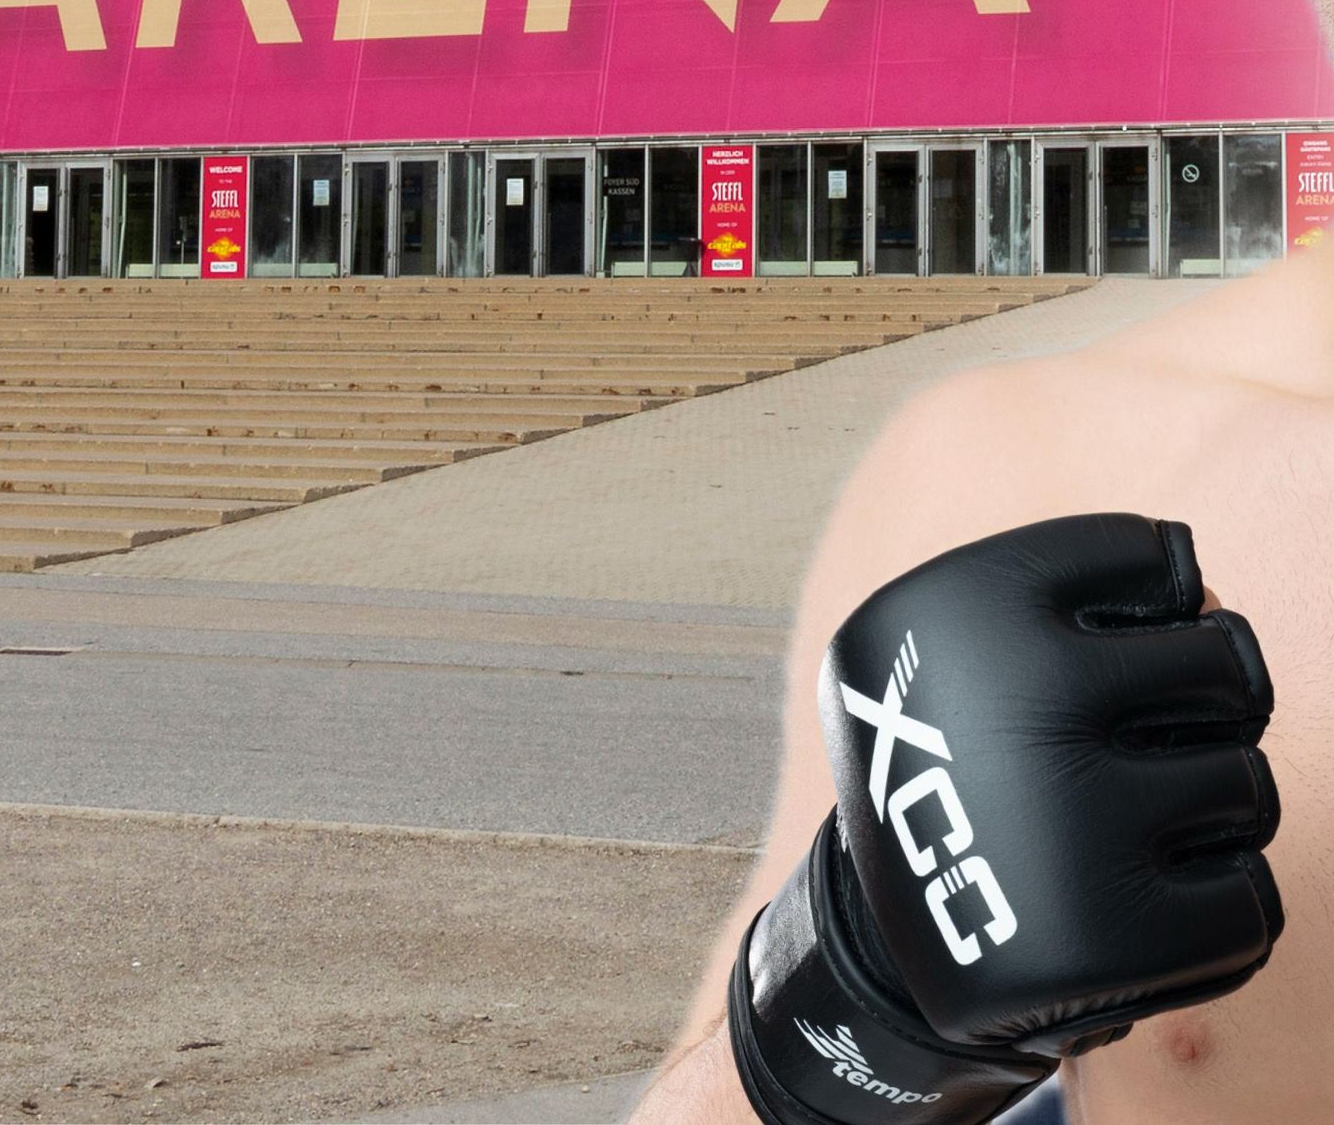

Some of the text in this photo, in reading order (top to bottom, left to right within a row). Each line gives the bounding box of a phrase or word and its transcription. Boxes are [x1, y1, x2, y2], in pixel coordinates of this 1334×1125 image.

[209, 165, 244, 174] WELCOME
[211, 189, 239, 208] STEFFL
[711, 181, 744, 201] STEFFL
[209, 209, 242, 219] ARENA
[709, 202, 747, 213] ARENA
[832, 1061, 943, 1105] tempo
